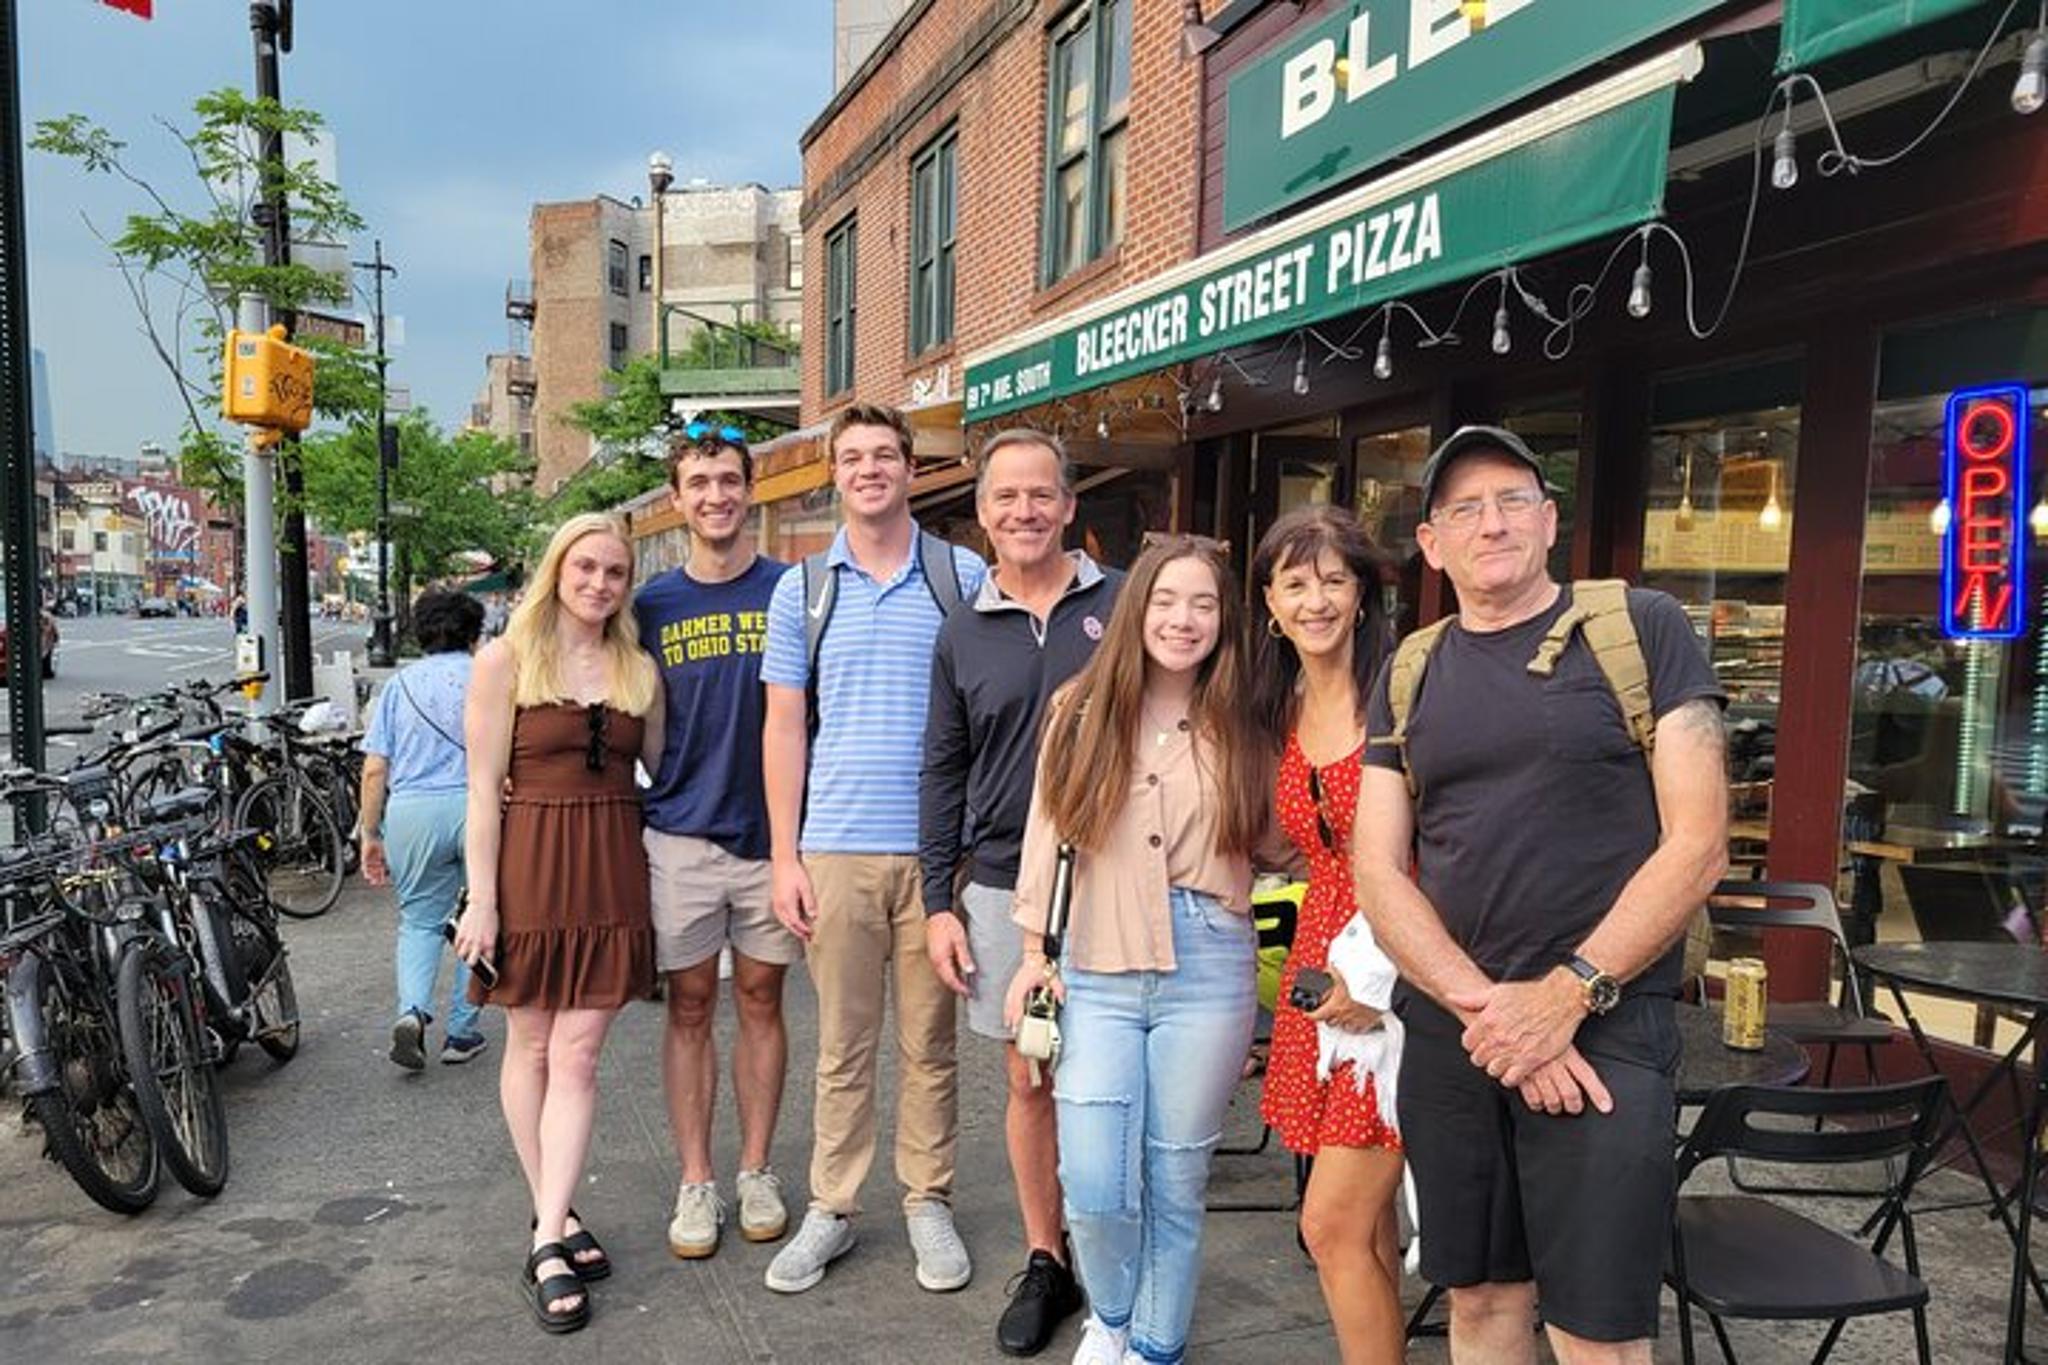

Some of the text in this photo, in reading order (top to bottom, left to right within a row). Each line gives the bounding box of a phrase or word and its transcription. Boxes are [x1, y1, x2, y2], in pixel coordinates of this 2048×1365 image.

[1281, 0, 1535, 140] BLE
[1075, 192, 1443, 377] BLEECKER STREET PIZZA
[1015, 360, 1050, 396] SOUTH
[1957, 401, 2015, 631] OPEN
[661, 611, 767, 645] DAHMER WE
[663, 642, 684, 667] TO
[687, 635, 731, 660] OHIO
